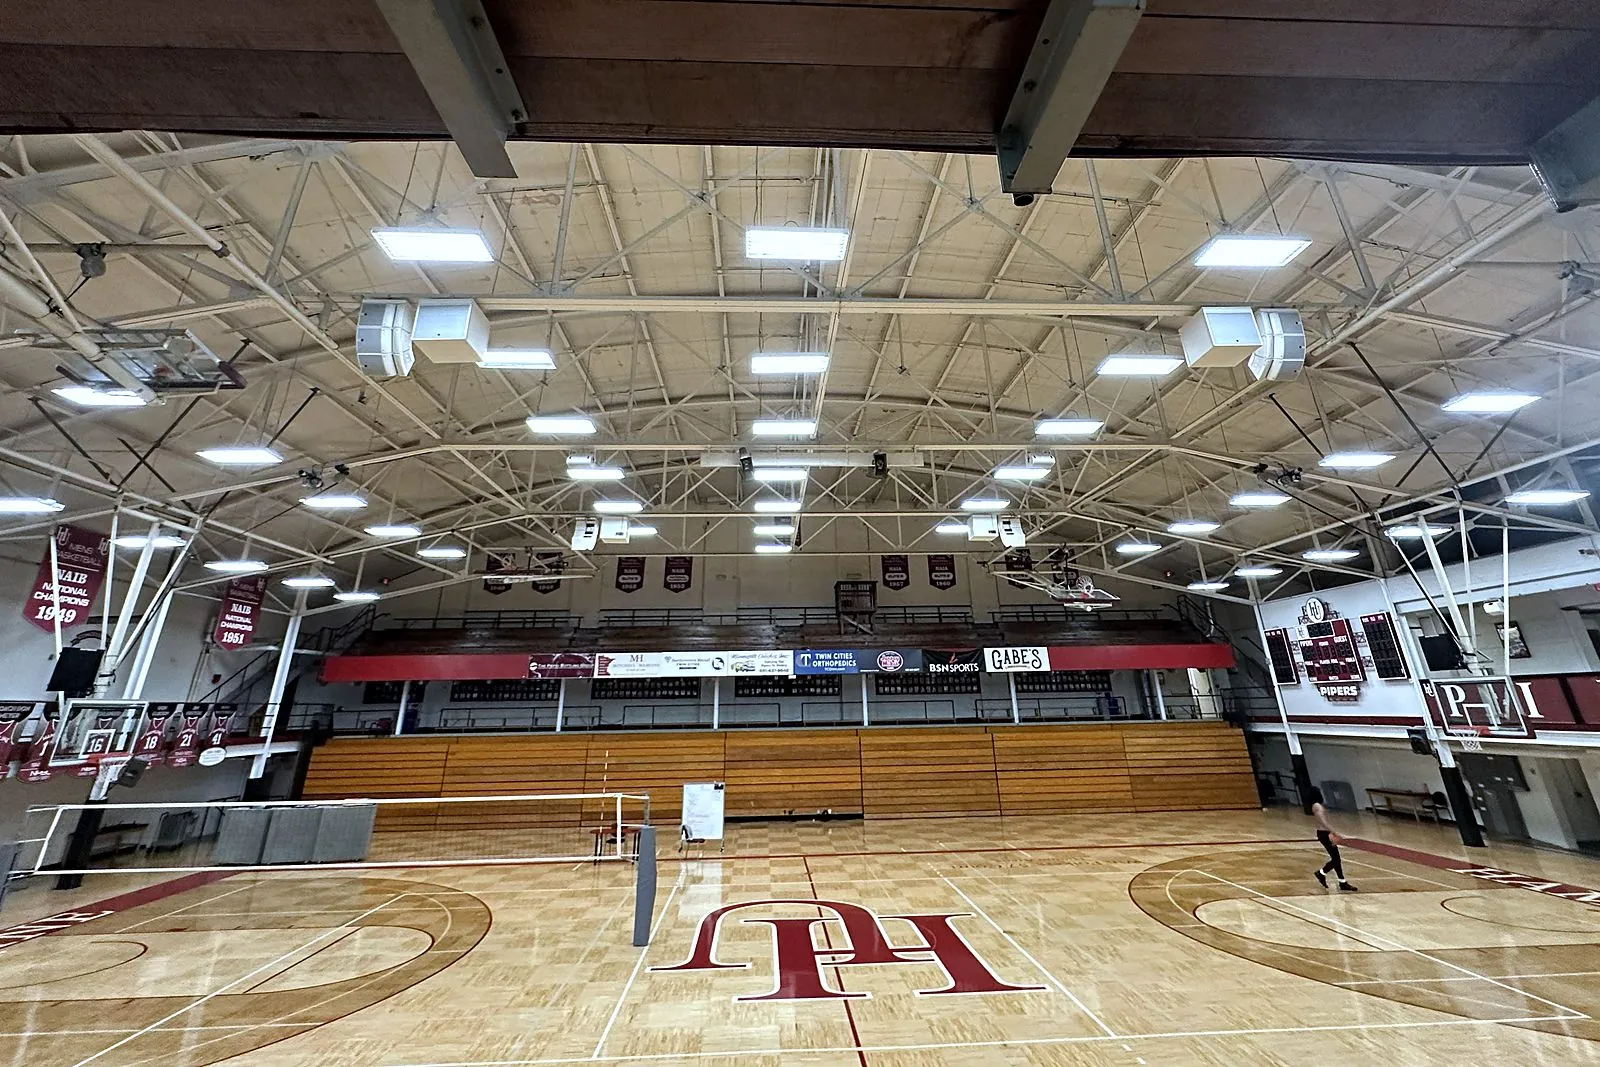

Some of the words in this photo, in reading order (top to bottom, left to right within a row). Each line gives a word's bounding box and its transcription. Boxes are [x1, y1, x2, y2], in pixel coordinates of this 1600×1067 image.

[58, 569, 88, 584] NAIB
[35, 605, 76, 623] 1949
[231, 603, 252, 614] NAIB
[221, 631, 245, 644] 1951
[833, 652, 853, 660] CITIES
[992, 649, 1042, 670] GABE'S
[812, 660, 857, 668] ORTHOPEDICS
[929, 664, 950, 672] BSN
[950, 663, 979, 672] SPORTS
[1319, 685, 1358, 696] PIPERS
[87, 738, 104, 752] 16
[144, 736, 158, 749] 18
[180, 734, 193, 746] 21
[212, 733, 223, 745] 41
